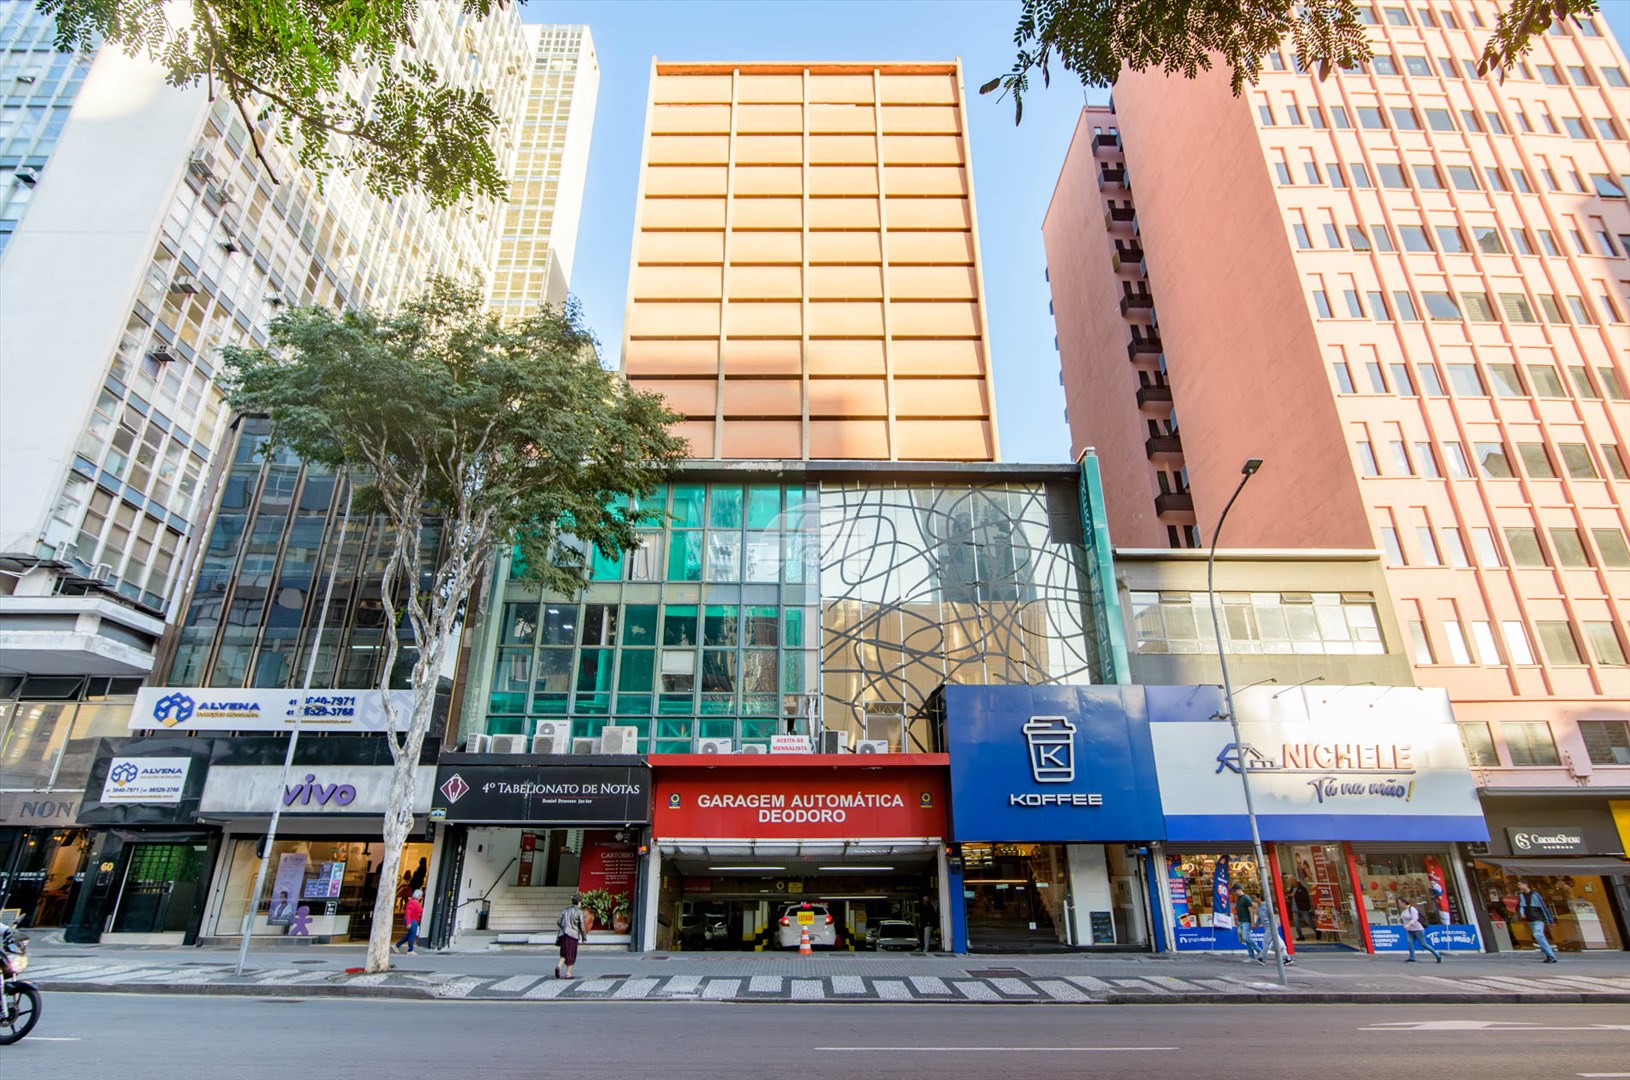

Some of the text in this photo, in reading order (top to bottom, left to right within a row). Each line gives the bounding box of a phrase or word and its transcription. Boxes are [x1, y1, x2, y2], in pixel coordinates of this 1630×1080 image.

[198, 702, 260, 711] ALVENA
[303, 706, 354, 716] 8529-3768
[1039, 745, 1065, 766] K
[1282, 743, 1414, 770] NICHELE
[283, 773, 357, 807] vivo
[1306, 776, 1338, 803] Tá
[697, 791, 904, 808] GARAGEM AUTOMÁTICA
[1010, 794, 1103, 806] KOFFEE
[758, 810, 846, 823] DEODORO
[101, 862, 114, 871] 60
